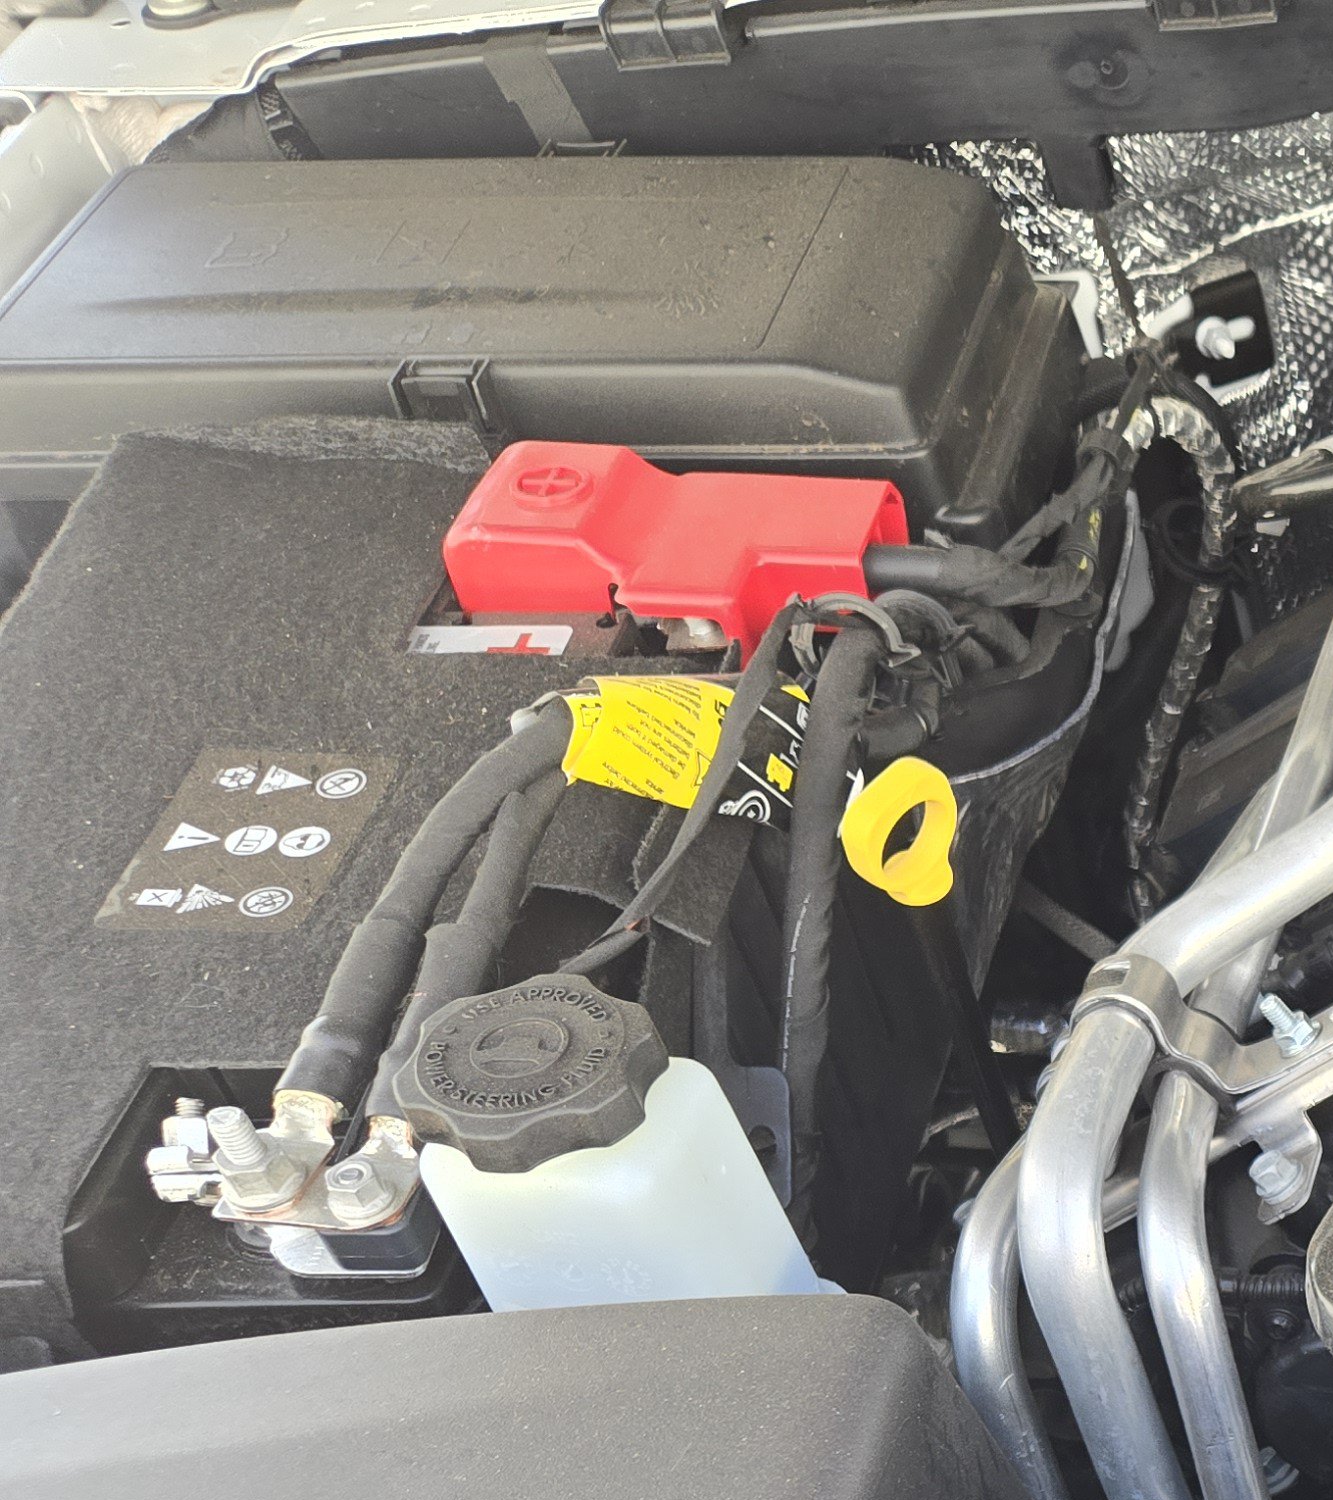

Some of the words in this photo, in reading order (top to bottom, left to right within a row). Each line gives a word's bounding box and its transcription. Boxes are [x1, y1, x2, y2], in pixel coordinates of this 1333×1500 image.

[461, 999, 502, 1021] USE
[509, 987, 609, 1023] APPROVED
[425, 1040, 456, 1096] POWER
[450, 1083, 558, 1109] STEERING
[561, 1046, 606, 1088] FLUID
